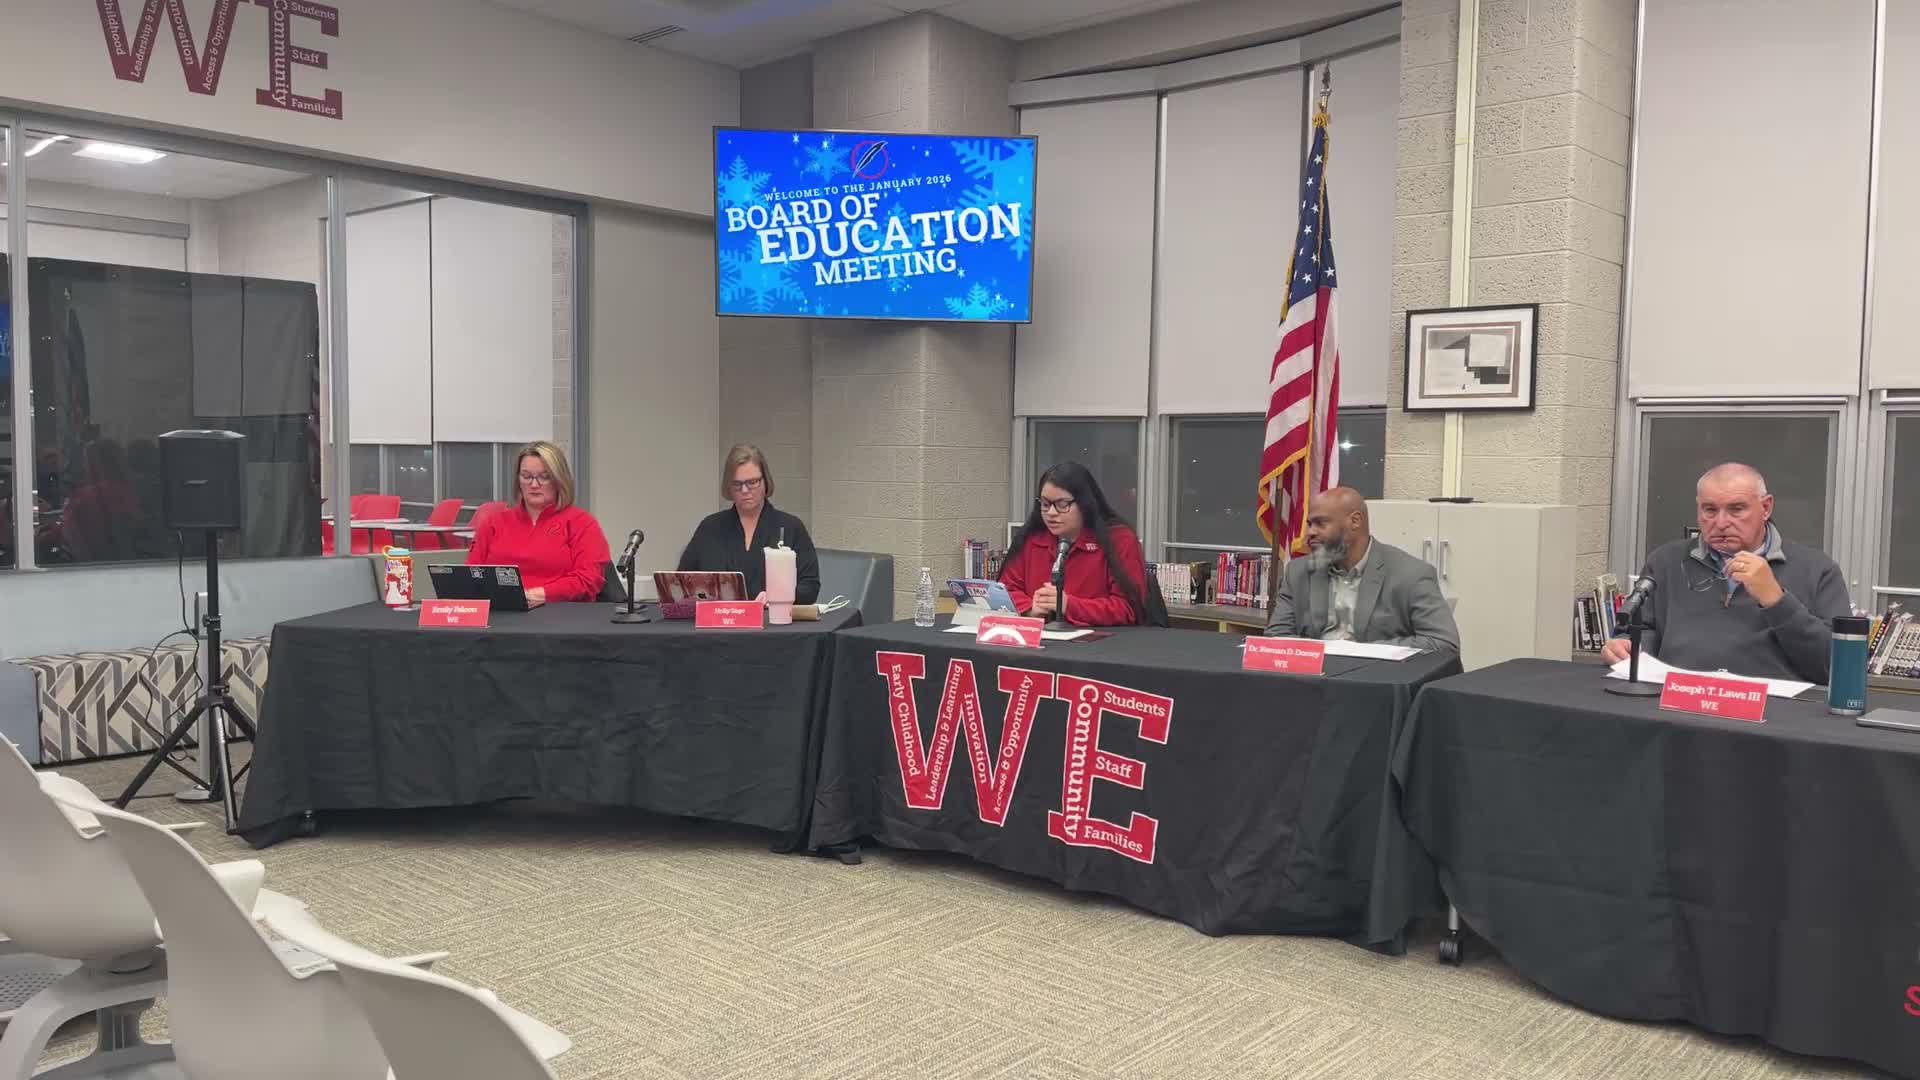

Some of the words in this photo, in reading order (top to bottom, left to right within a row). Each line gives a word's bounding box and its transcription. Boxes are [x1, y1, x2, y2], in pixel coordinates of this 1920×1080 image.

[103, 0, 126, 55] hildhood
[291, 2, 336, 20] Students
[130, 25, 153, 78] Leadership
[145, 14, 156, 23] &
[170, 0, 194, 65] nnovation
[202, 57, 216, 90] Access
[209, 48, 219, 57] &
[272, 0, 289, 106] Community
[292, 49, 320, 63] Staff
[291, 98, 337, 115] Families
[765, 187, 821, 201] WELCOME
[824, 186, 839, 195] TO
[842, 183, 865, 194] THE
[870, 178, 922, 191] JANUARY
[926, 174, 952, 185] 2026
[726, 198, 832, 232] BOARD
[840, 193, 880, 221] OF
[756, 202, 1022, 264] EDUCATION
[812, 247, 957, 286] MEETING
[892, 664, 905, 699] Early
[1274, 659, 1288, 668] WE
[943, 664, 963, 721] Learning
[1104, 690, 1166, 717] Students
[1668, 682, 1706, 696] Joseph
[1707, 686, 1716, 696] T.
[1719, 687, 1746, 700] Laws
[1748, 691, 1761, 702] III
[1700, 700, 1719, 711] WE
[940, 722, 950, 732] &
[1003, 675, 1033, 758] Opportunity
[876, 651, 1174, 864] WE
[898, 702, 921, 777] Childhood
[964, 692, 987, 784] Innovation
[925, 735, 950, 801] Leadership
[1001, 760, 1011, 771] &
[1064, 684, 1099, 839] Community
[1095, 757, 1133, 779] Staff
[993, 773, 1008, 814] Access
[1084, 825, 1143, 853] Families
